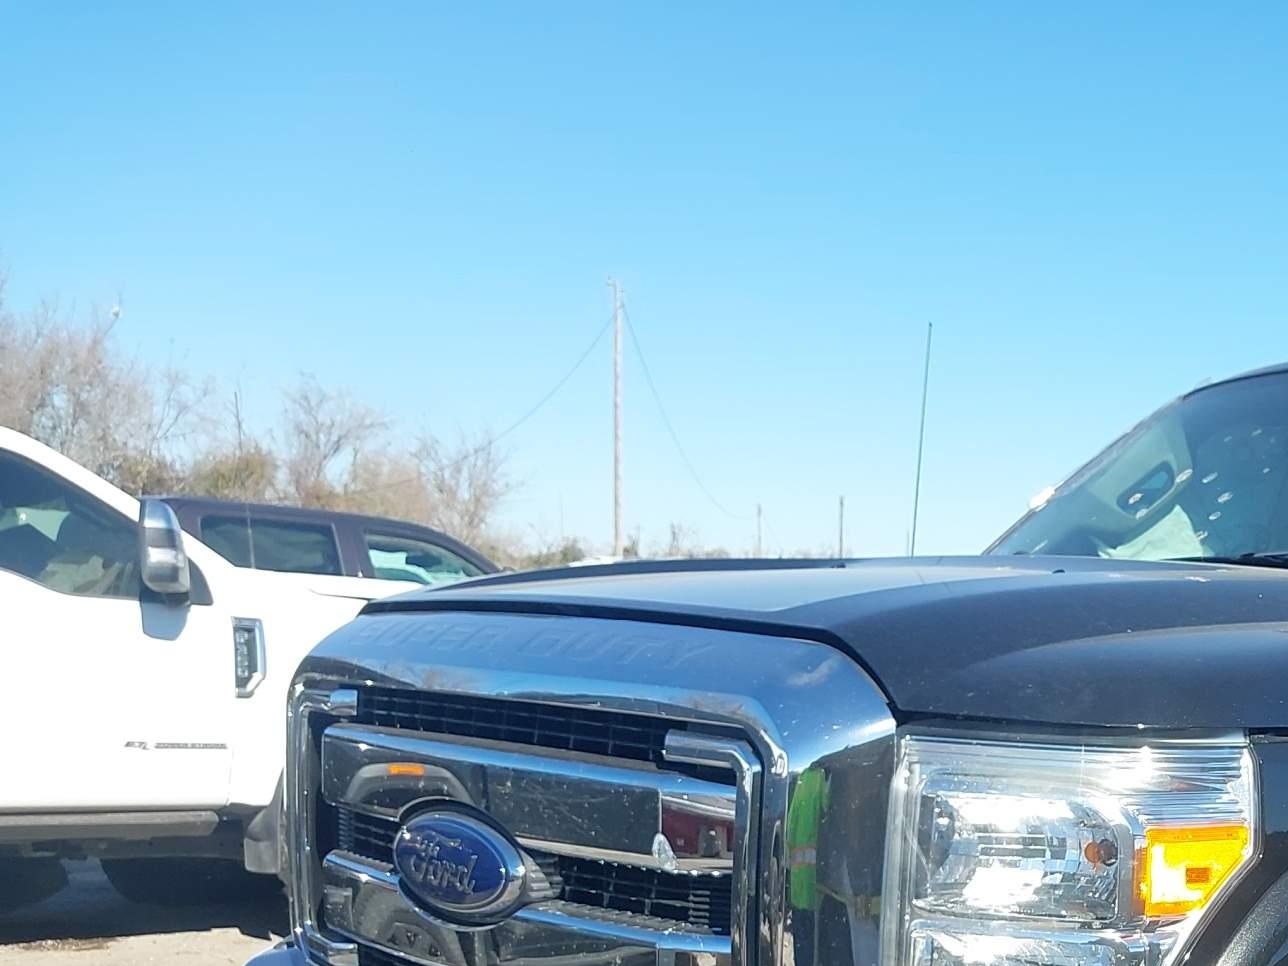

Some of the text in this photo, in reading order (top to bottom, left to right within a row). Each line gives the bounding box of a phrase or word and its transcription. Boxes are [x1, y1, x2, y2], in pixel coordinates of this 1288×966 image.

[349, 618, 718, 670] SUPER DUTY
[410, 832, 479, 896] Ford
